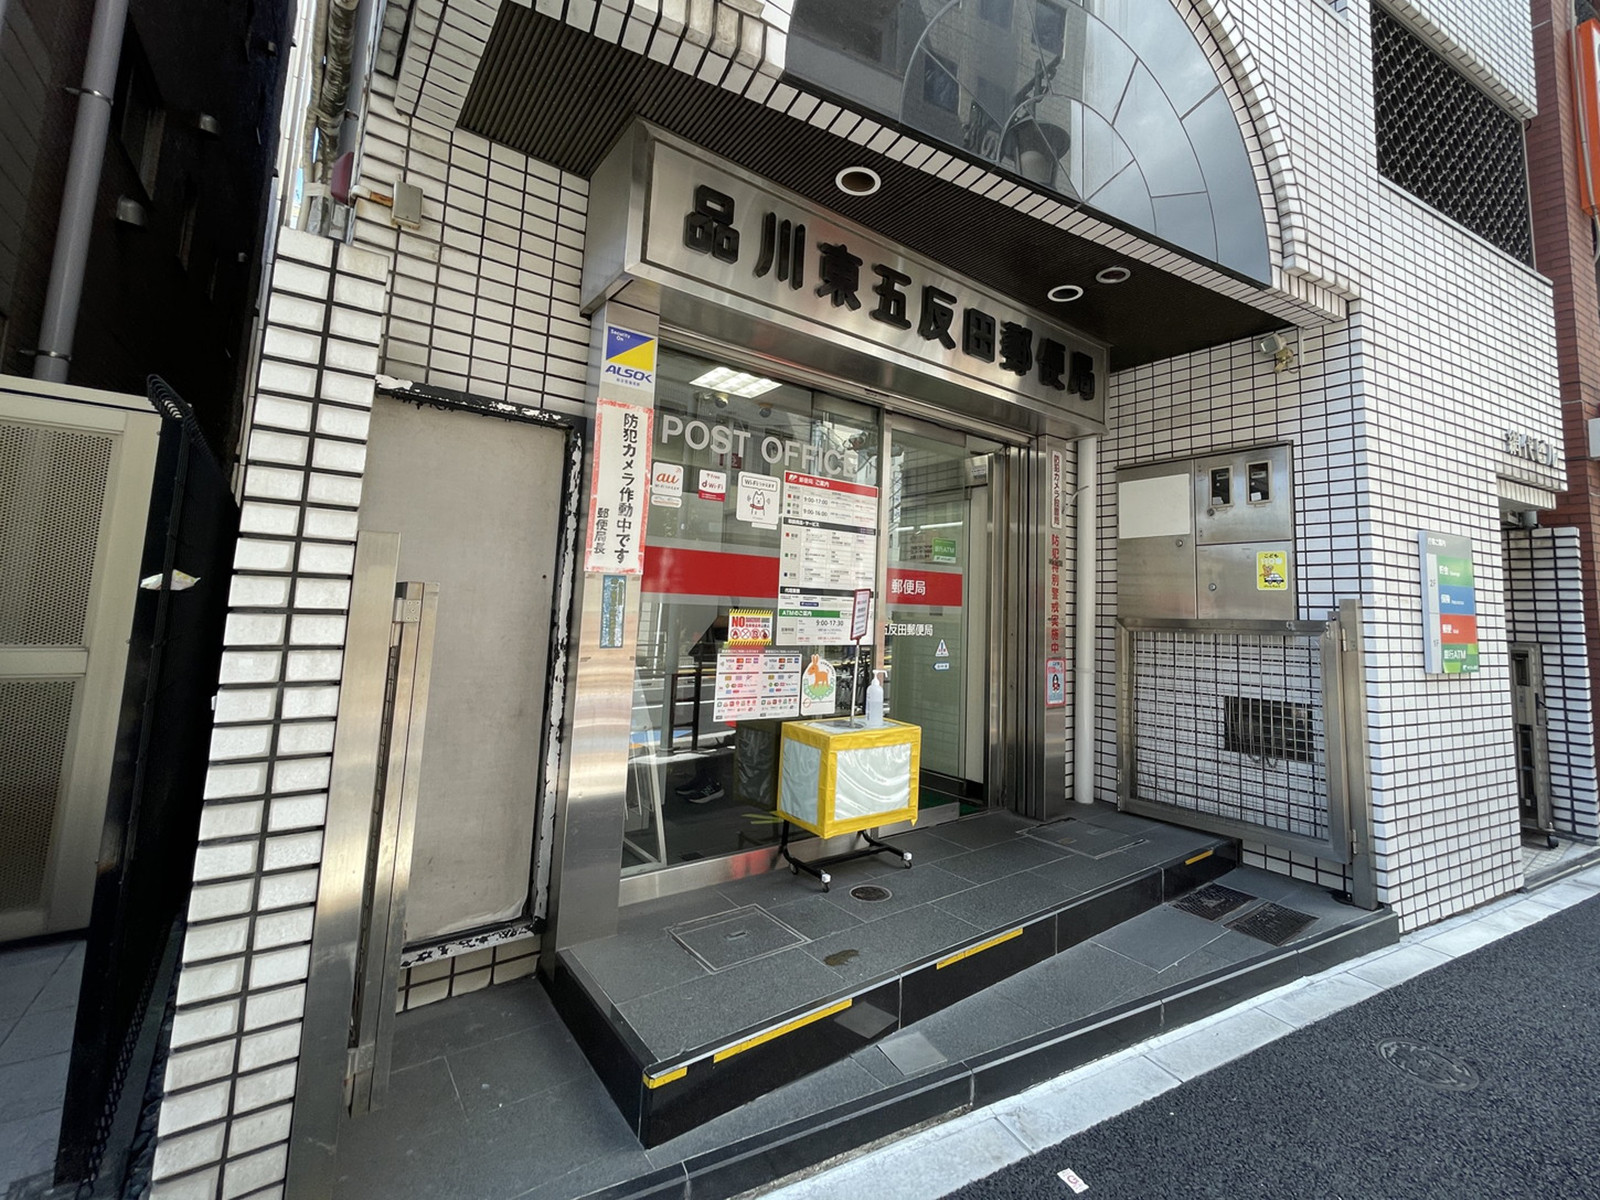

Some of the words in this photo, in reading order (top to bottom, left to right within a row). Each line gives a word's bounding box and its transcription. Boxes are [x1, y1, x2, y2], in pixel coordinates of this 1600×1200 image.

[683, 183, 1096, 401] 品川東五反田郵便局
[605, 364, 653, 384] ALSOK
[661, 414, 750, 458] POST
[761, 436, 858, 479] OFFICE
[613, 412, 639, 564] 防犯カメラ作動中です
[656, 472, 679, 484] au
[593, 506, 610, 555] 郵便局長
[891, 578, 926, 596] 郵便局
[731, 616, 746, 628] NO
